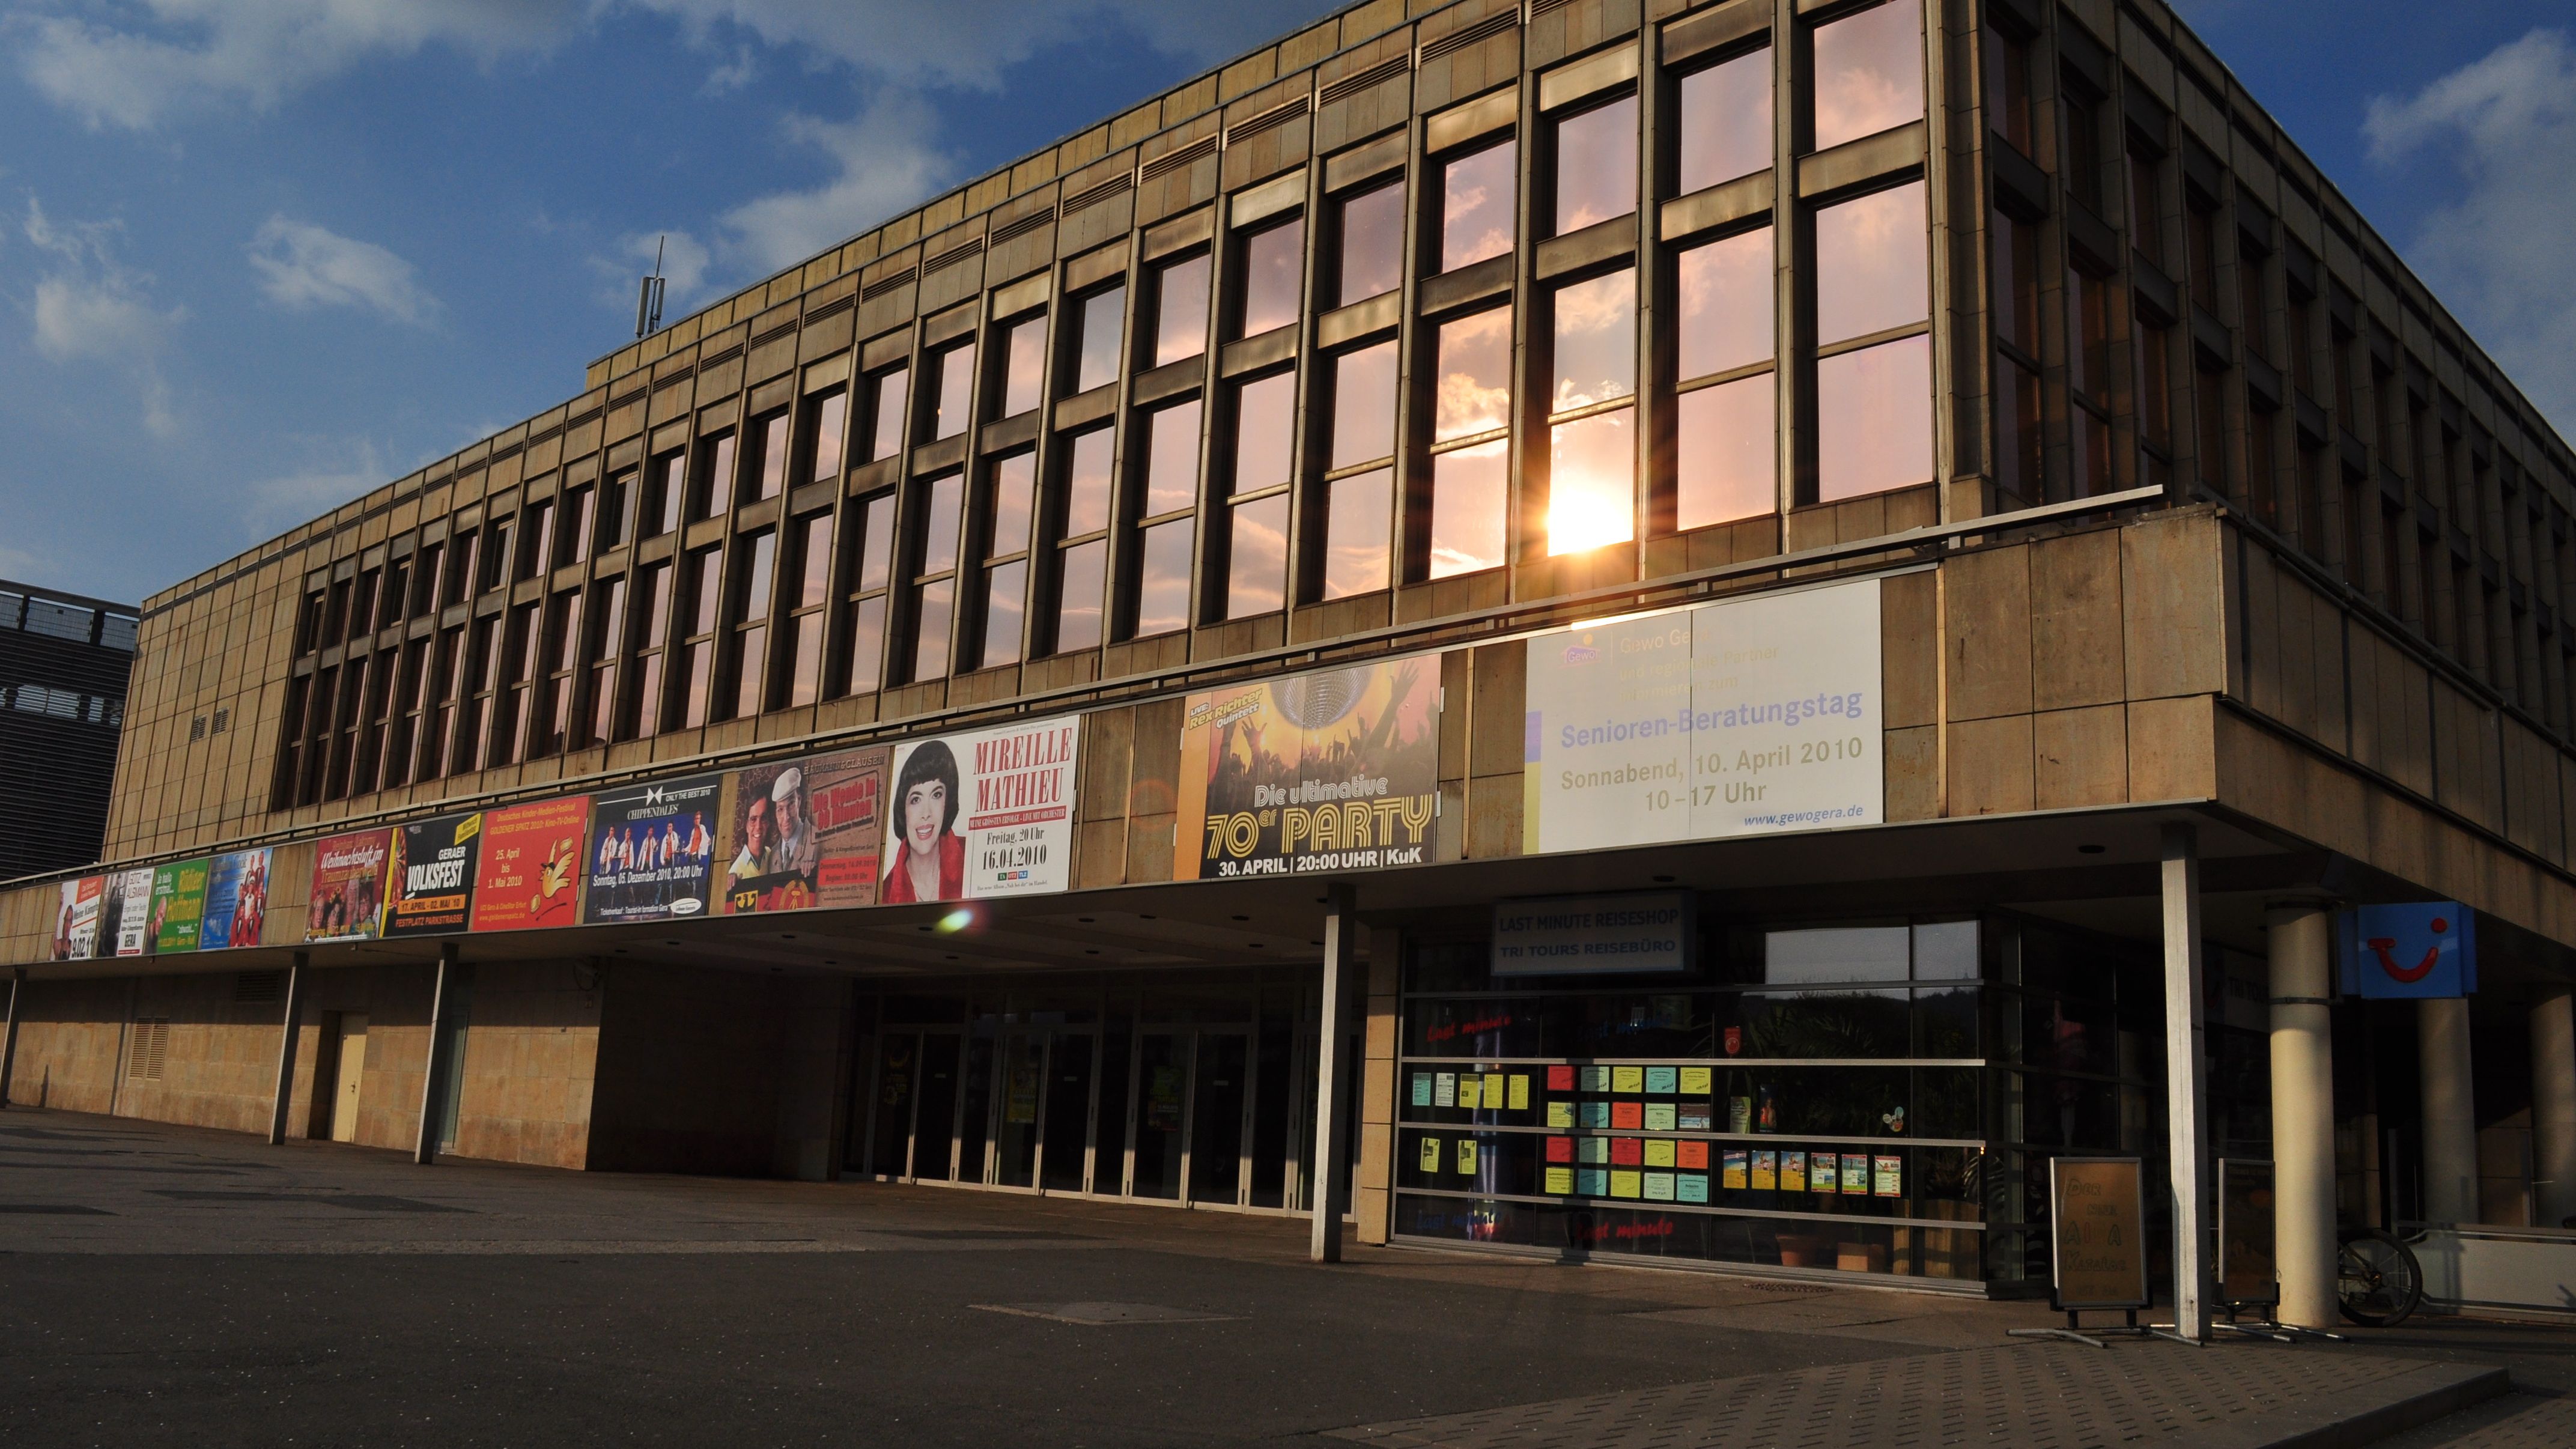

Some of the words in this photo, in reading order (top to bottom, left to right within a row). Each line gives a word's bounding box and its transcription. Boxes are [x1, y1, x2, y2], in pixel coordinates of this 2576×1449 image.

[1620, 635, 1663, 654] Gewo
[1669, 628, 1710, 646] Gea
[1567, 650, 1596, 662] Gewo
[1724, 645, 1779, 664] Partner
[1189, 711, 1214, 731] Rex
[1214, 688, 1263, 718] Richter
[1190, 702, 1209, 717] LIVE:
[1561, 691, 1863, 749] Senioren-Beratungstag
[973, 727, 1072, 775] MIREILLE
[1561, 758, 1684, 790] Sonnabend,
[1695, 753, 1728, 775] 10.
[1736, 744, 1791, 775] April
[1800, 737, 1863, 764] 2010
[666, 794, 678, 802] ONLY
[699, 789, 711, 797] 2010
[813, 793, 828, 813] Die
[830, 781, 864, 808] Wende
[866, 778, 875, 797] in
[975, 767, 1064, 813] MATHIEU
[1254, 783, 1286, 807] Die
[1290, 774, 1388, 804] ultimative
[1725, 781, 1767, 804] Uhr
[497, 813, 521, 822] Deutsches
[521, 803, 576, 818] Kinder-Medien-Festival
[627, 804, 679, 820] CHIPPENDALES
[831, 798, 872, 826] Minuten
[1022, 812, 1033, 821] LIVE
[1040, 809, 1065, 819] ORCHESTER
[1744, 804, 1863, 827] www.gewogera.de
[490, 824, 515, 835] GOLDENER
[515, 822, 530, 831] SPATZ
[530, 820, 544, 830] 2010:
[545, 816, 580, 827] Kino-TV-Online
[1281, 794, 1433, 854] PARTY
[987, 831, 1017, 845] Freitag,
[1019, 828, 1028, 841] 20
[1030, 827, 1045, 840] Uhr
[439, 846, 466, 860] GERAER
[495, 850, 505, 860] 25.
[506, 848, 520, 862] April
[983, 844, 1047, 870] 16.04.2010
[1218, 861, 1240, 877] 30.
[1242, 857, 1287, 875] APRIL
[1296, 853, 1339, 872] 20:00
[1341, 850, 1378, 869] UHR
[1387, 846, 1422, 865] KuK
[407, 860, 465, 892] VOLKSFEST
[501, 863, 510, 873] bis
[593, 874, 617, 888] Sonntag,
[618, 873, 627, 884] 05.
[627, 870, 656, 884] Dezember
[657, 869, 672, 882] 2010,
[674, 867, 690, 879] 20:00
[691, 864, 703, 877] Uhr
[488, 878, 493, 889] 1.
[494, 877, 506, 888] Mai
[507, 875, 523, 887] 2010
[410, 902, 426, 911] APRIL
[430, 901, 439, 910] 02.
[440, 899, 451, 909] MAI
[395, 917, 424, 928] FESTPLATZ
[425, 914, 464, 925] PARKSTRASSE
[1499, 917, 1534, 932] LAST
[1537, 913, 1591, 929] MINUTE
[1595, 908, 1680, 928] REISESHOP
[124, 934, 136, 947] GERA
[1501, 947, 1523, 958] TRI
[1528, 944, 1579, 956] TOURS
[1585, 938, 1675, 954] REISEBÜRO
[1462, 1014, 1513, 1035] minute
[1616, 1217, 1673, 1239] minute
[2063, 1220, 2122, 1246] AIA
